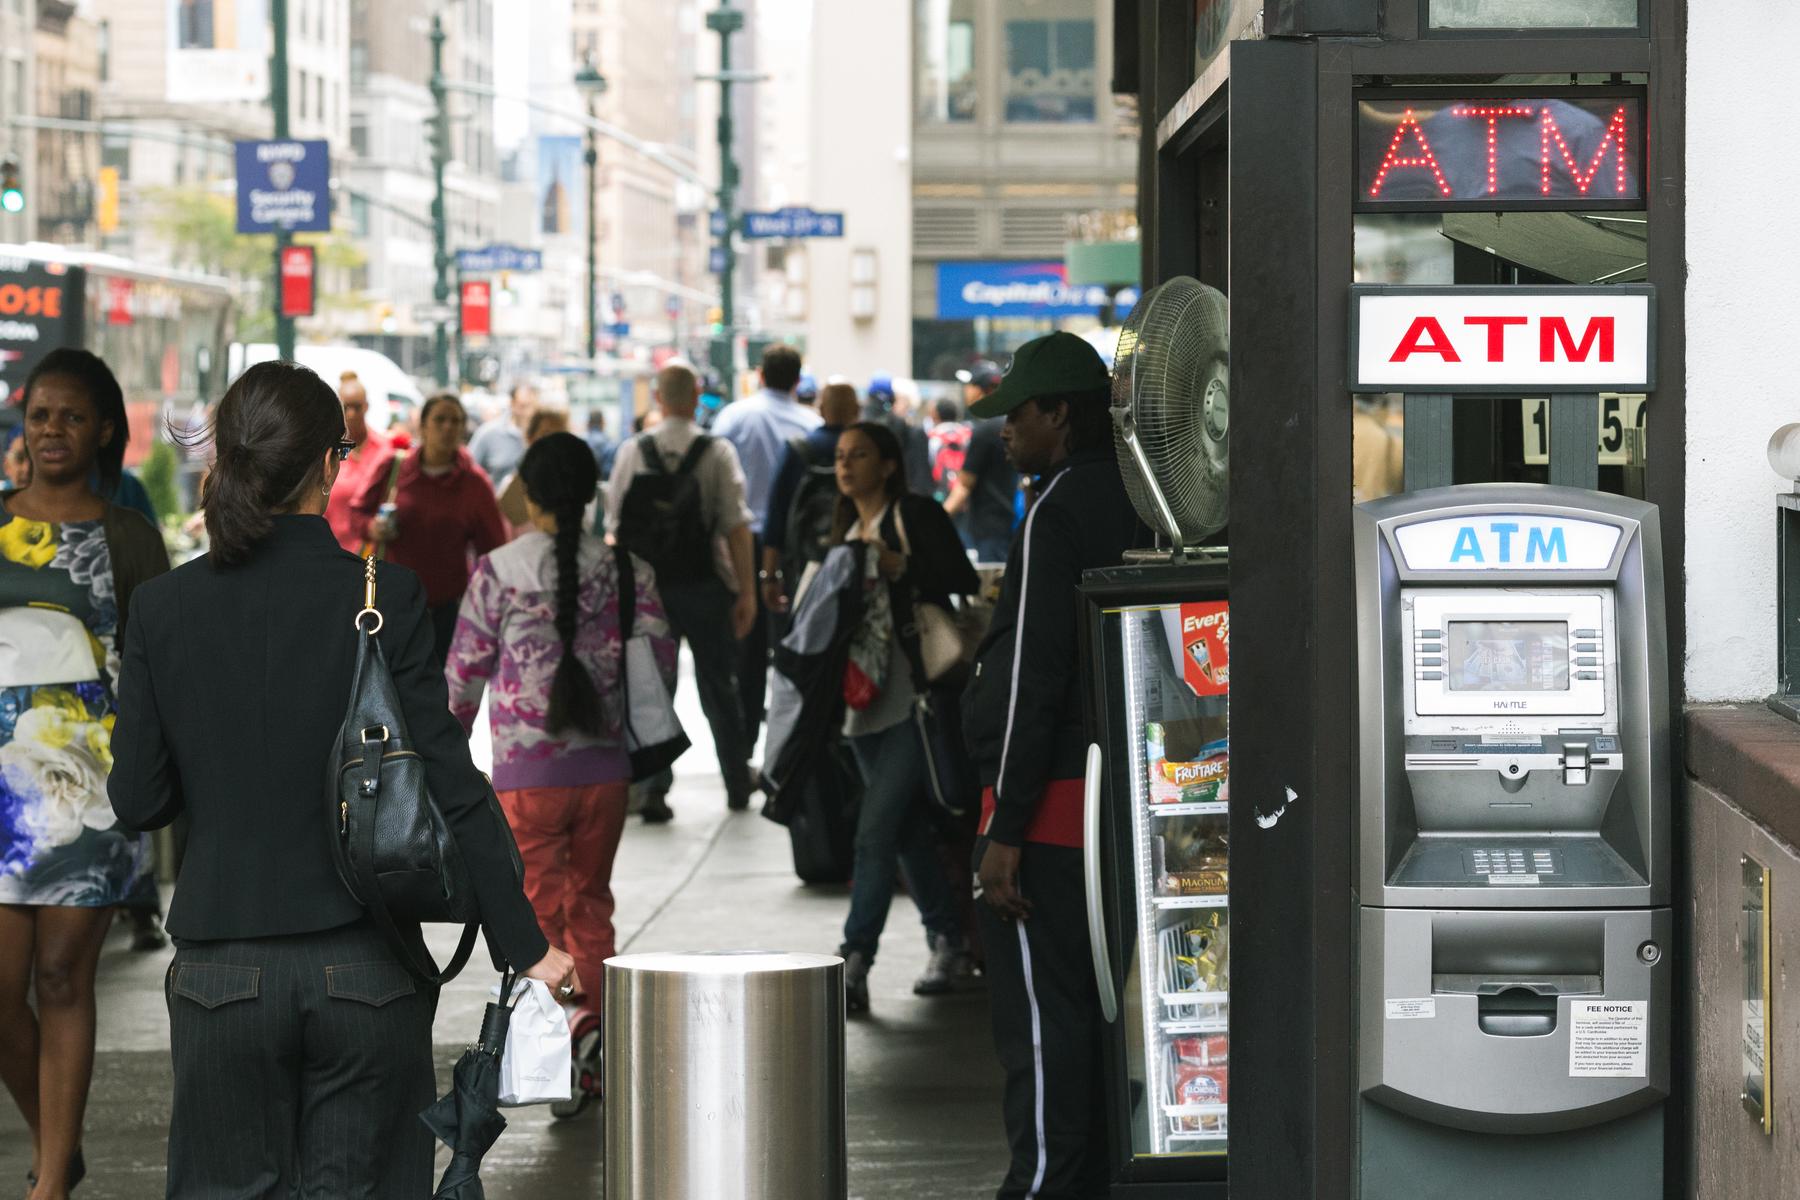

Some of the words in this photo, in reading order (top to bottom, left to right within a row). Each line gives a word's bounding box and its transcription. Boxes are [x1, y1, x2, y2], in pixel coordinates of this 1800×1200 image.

[1370, 107, 1624, 195] ATM
[249, 190, 315, 207] Security
[1388, 316, 1615, 363] ATM
[1449, 523, 1568, 563] ATM
[1175, 762, 1224, 785] FRUTTARE
[1181, 878, 1226, 888] MAGNUM
